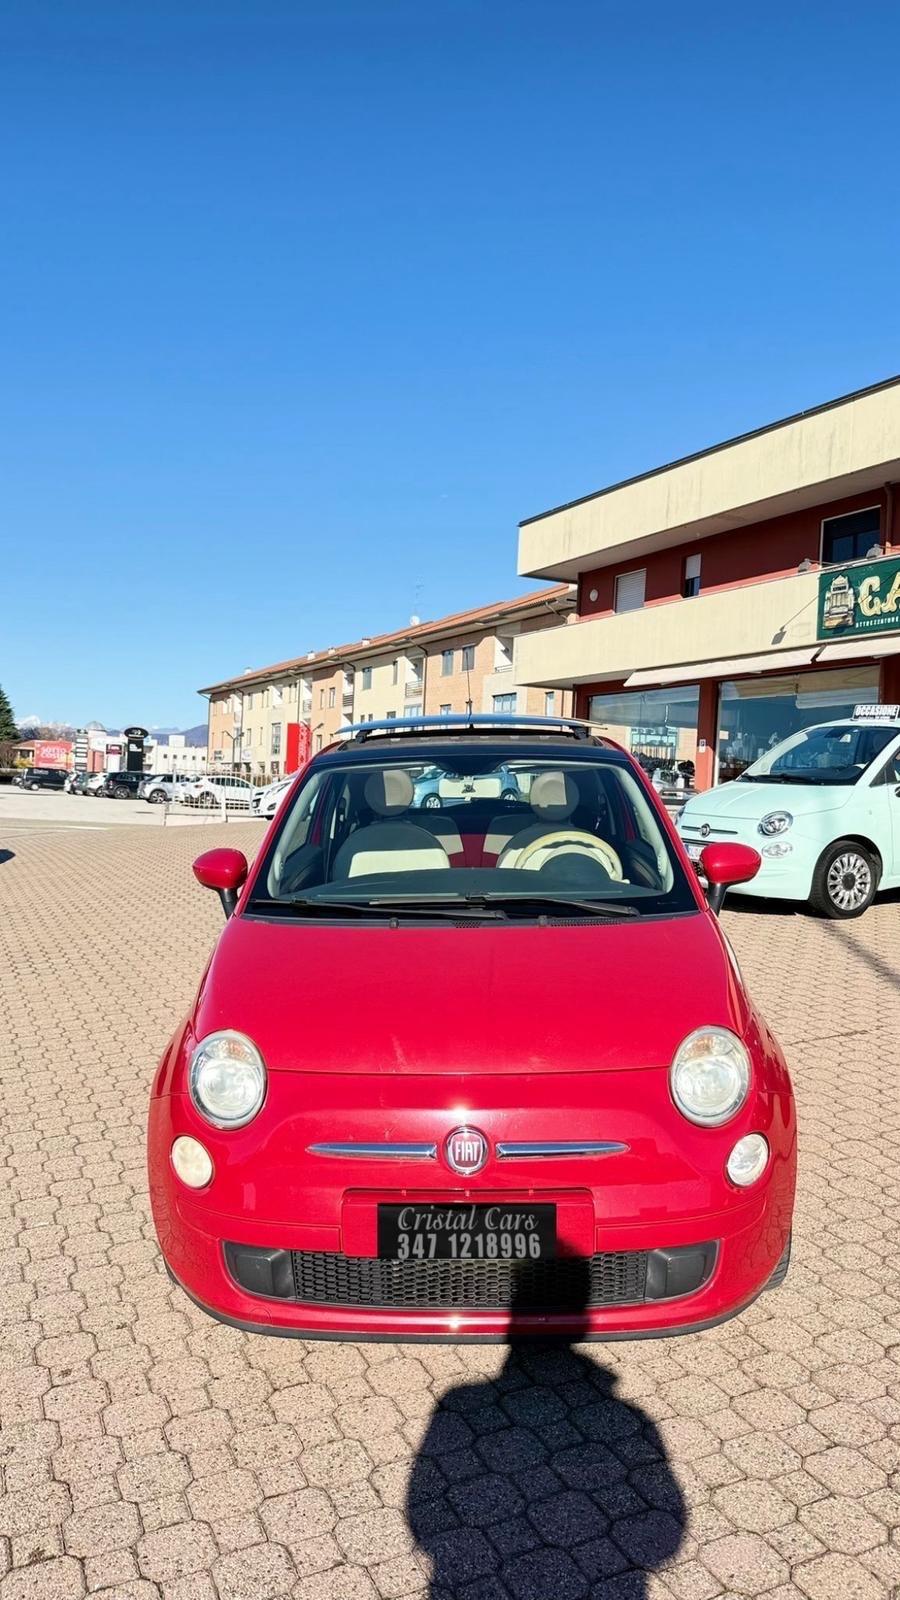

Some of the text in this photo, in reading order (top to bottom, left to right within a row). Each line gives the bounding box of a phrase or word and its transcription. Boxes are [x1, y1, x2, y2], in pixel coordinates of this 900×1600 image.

[455, 1141, 480, 1162] FIAT
[397, 1205, 539, 1231] Cristal Cars
[397, 1233, 541, 1260] 347 1218996
